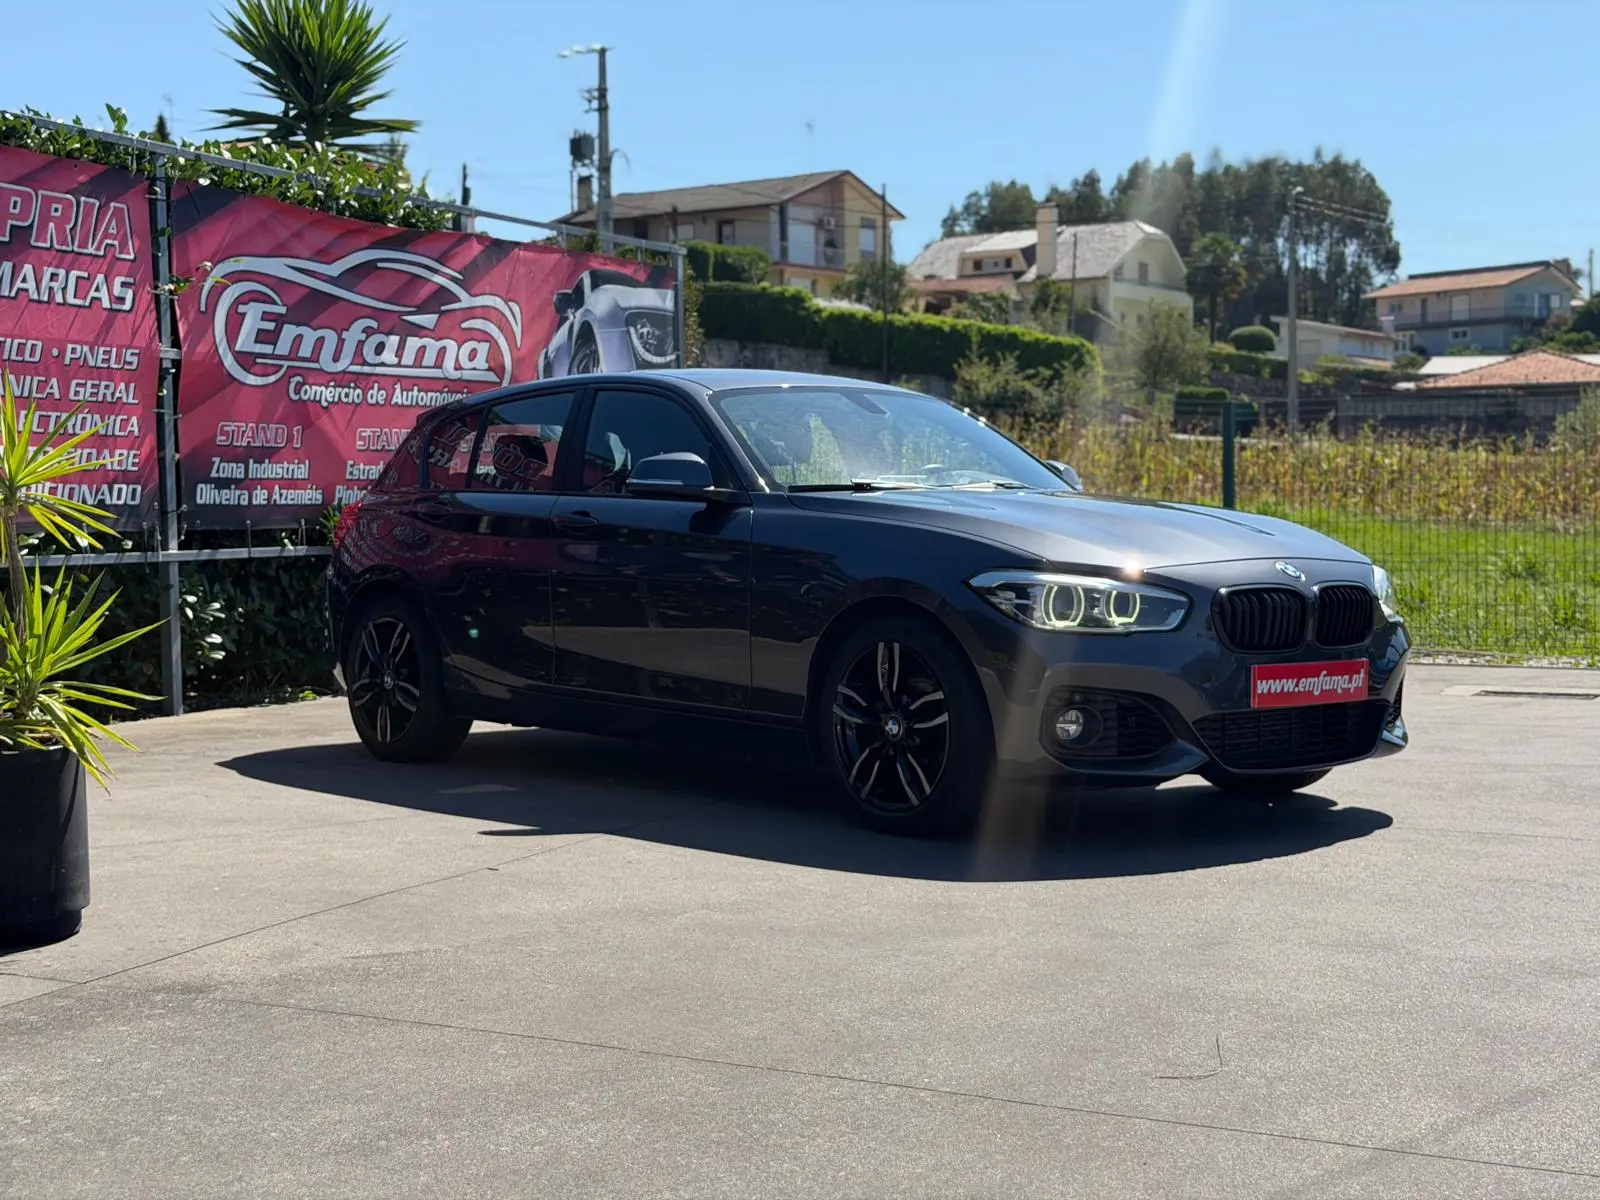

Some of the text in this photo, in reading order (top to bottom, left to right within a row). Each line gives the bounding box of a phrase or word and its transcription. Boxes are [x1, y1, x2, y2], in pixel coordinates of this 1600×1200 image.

[0, 182, 135, 260] PRIA
[0, 337, 140, 370] ICO PNEUS
[235, 301, 490, 380] Emfama
[69, 379, 139, 404] GERAL
[289, 376, 472, 408] Comércio de Automóve
[216, 422, 303, 449] STAND 1
[356, 428, 412, 450] STAN
[210, 457, 309, 479] Zona Industrial
[196, 483, 323, 506] Oliveira de Azeméis
[333, 485, 372, 505] Pinh
[1257, 668, 1365, 696] www.emfama.pt
